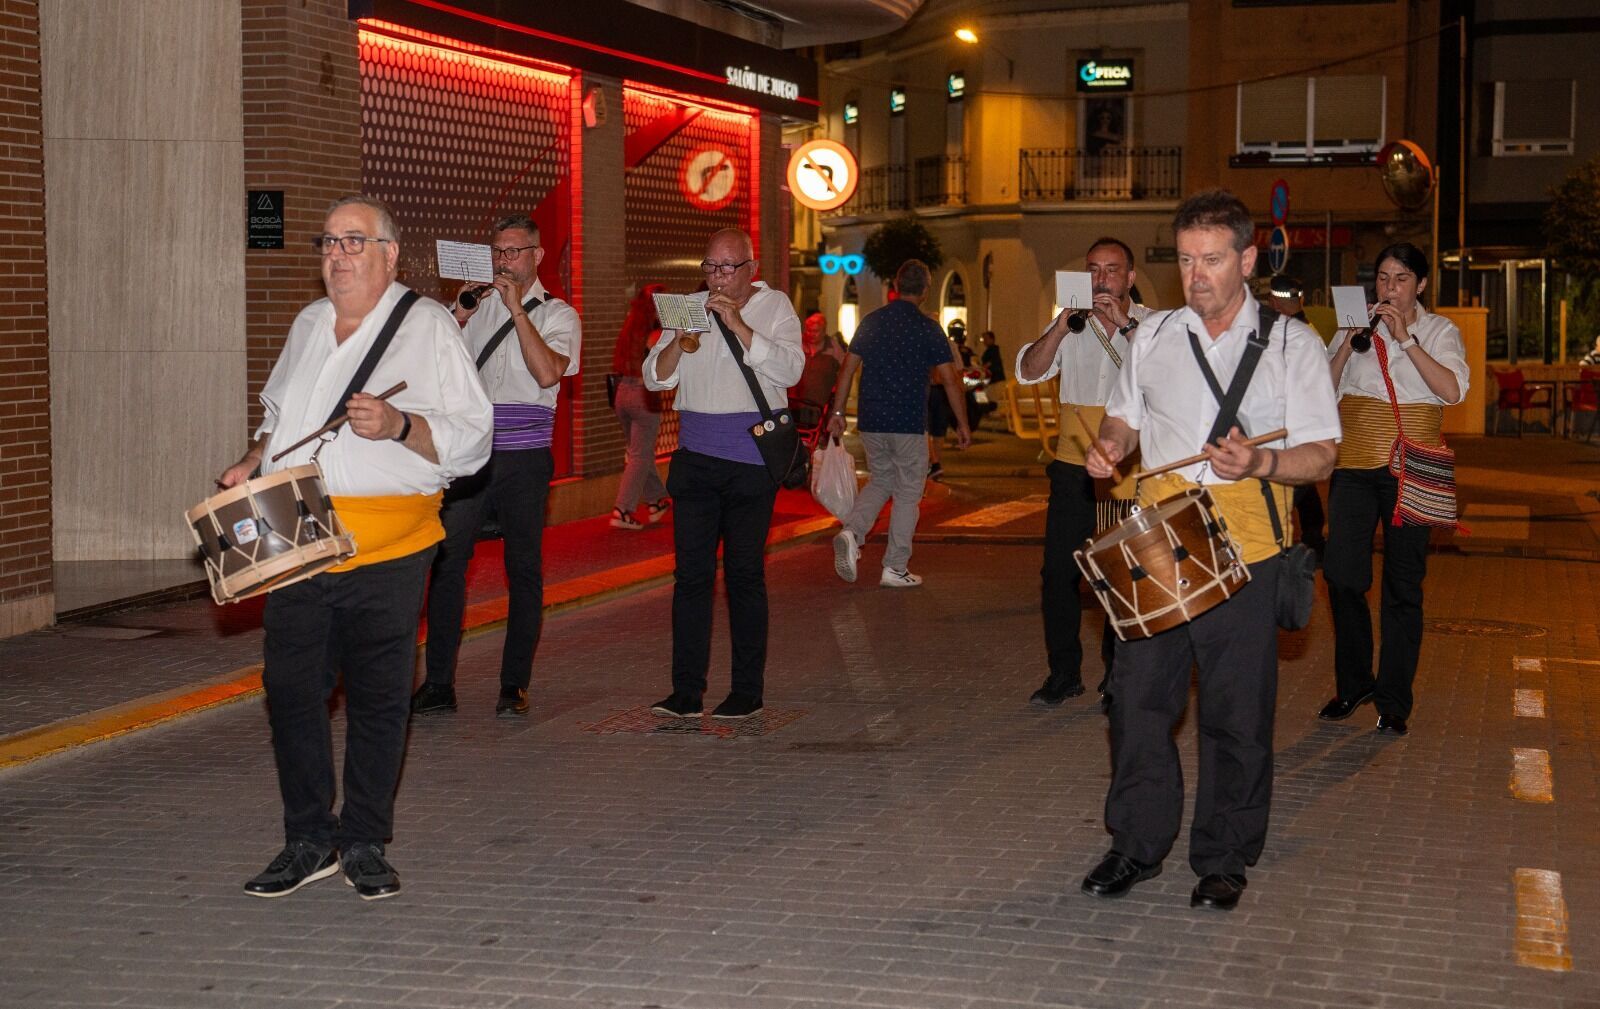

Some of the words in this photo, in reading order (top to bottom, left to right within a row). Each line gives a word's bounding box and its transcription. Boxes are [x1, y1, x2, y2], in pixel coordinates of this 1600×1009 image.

[726, 66, 757, 91] SALÓN
[757, 74, 771, 95] DE
[770, 78, 798, 100] JUEGO
